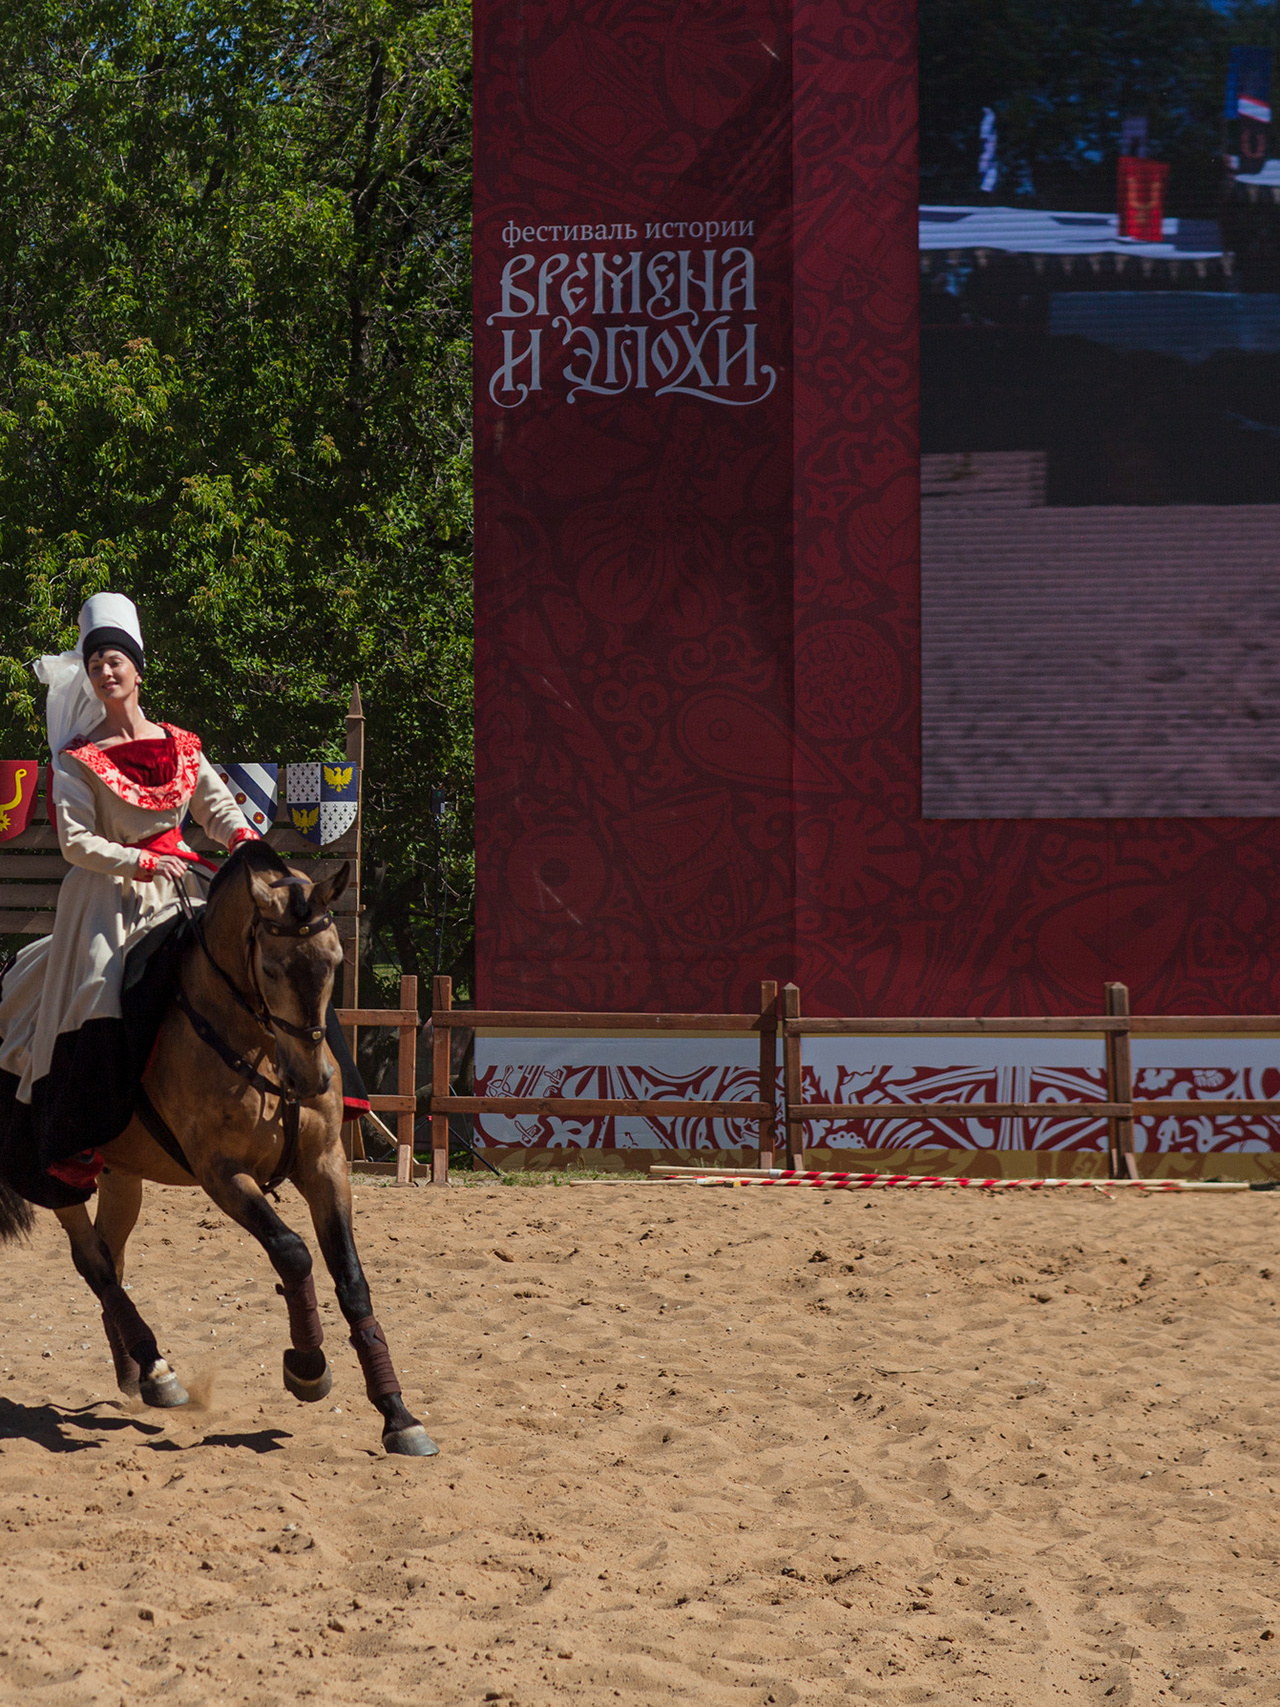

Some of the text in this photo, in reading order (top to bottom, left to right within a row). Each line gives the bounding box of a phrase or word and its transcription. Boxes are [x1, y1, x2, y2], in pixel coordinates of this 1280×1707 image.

[501, 220, 755, 248] фестиваль истории
[486, 247, 758, 326] ВРЕМЕНА
[489, 316, 777, 408] И ЭПОХИ
